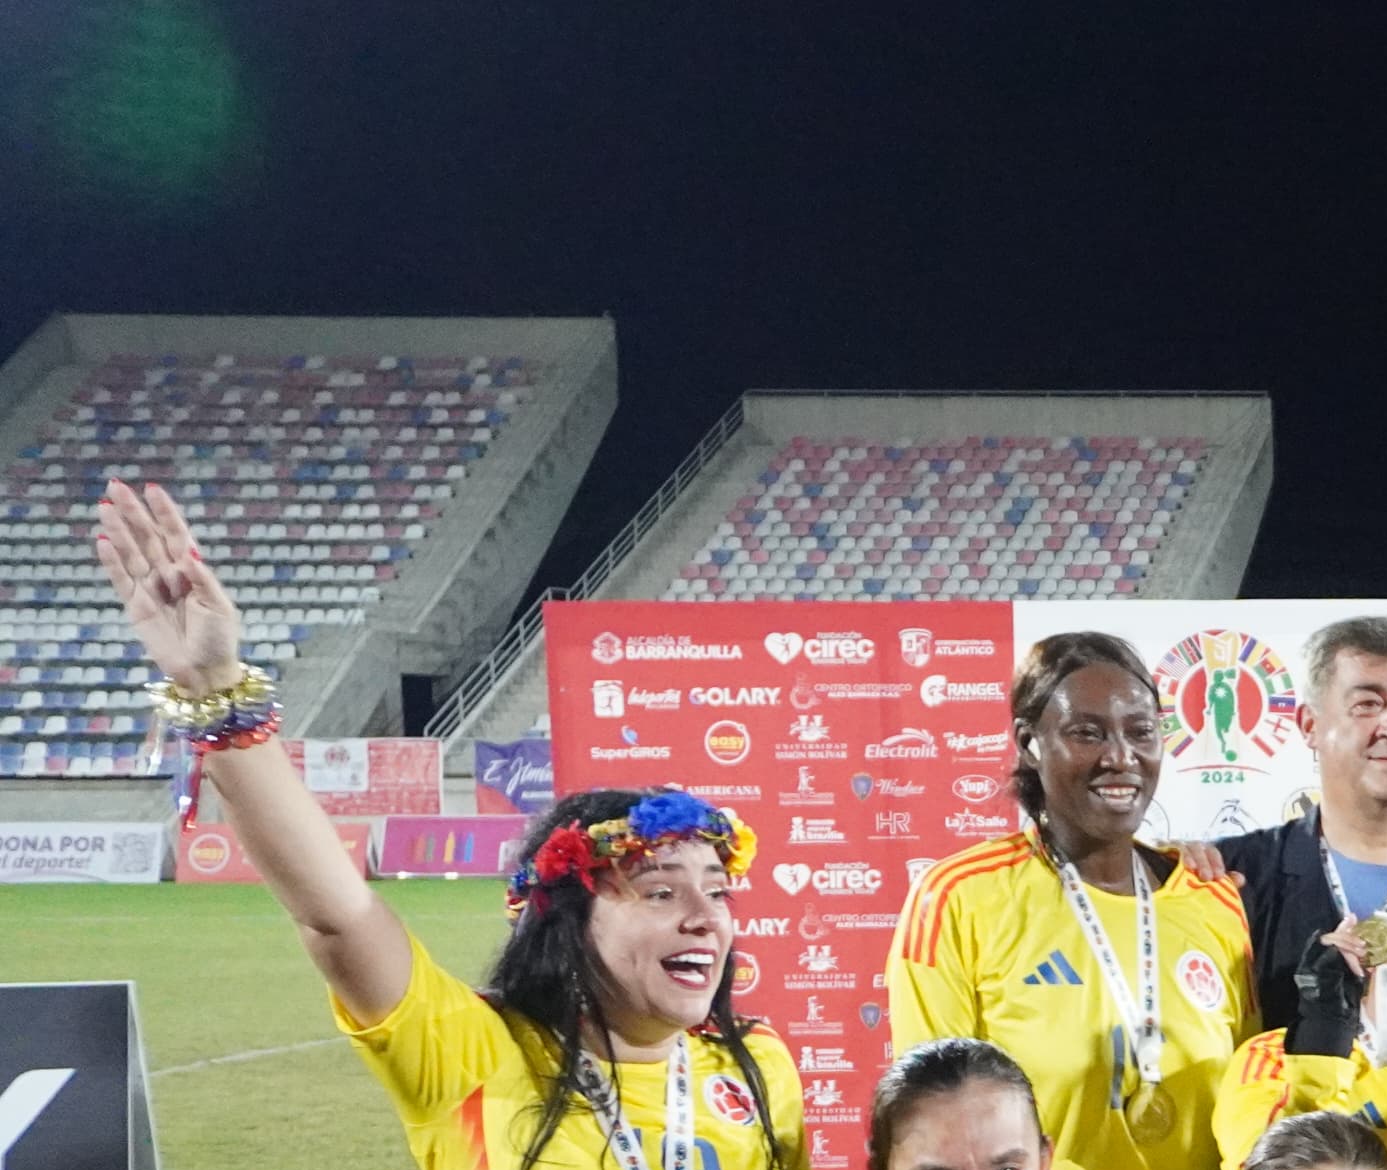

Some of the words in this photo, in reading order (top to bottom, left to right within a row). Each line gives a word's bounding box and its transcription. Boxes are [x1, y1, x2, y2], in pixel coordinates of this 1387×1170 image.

[678, 636, 691, 645] DE
[625, 644, 743, 660] BARRANQUILLA
[804, 638, 875, 659] cirec
[935, 645, 995, 655] ATLÁNTICO
[689, 687, 779, 706] GOLARY
[948, 682, 1004, 696] RANGEL
[709, 735, 744, 749] easy
[865, 744, 938, 759] Electrolit
[1200, 771, 1245, 783] 2024
[687, 785, 760, 795] AMERICANA
[60, 836, 105, 851] POR
[812, 868, 882, 888] cirec
[733, 918, 789, 936] LARY
